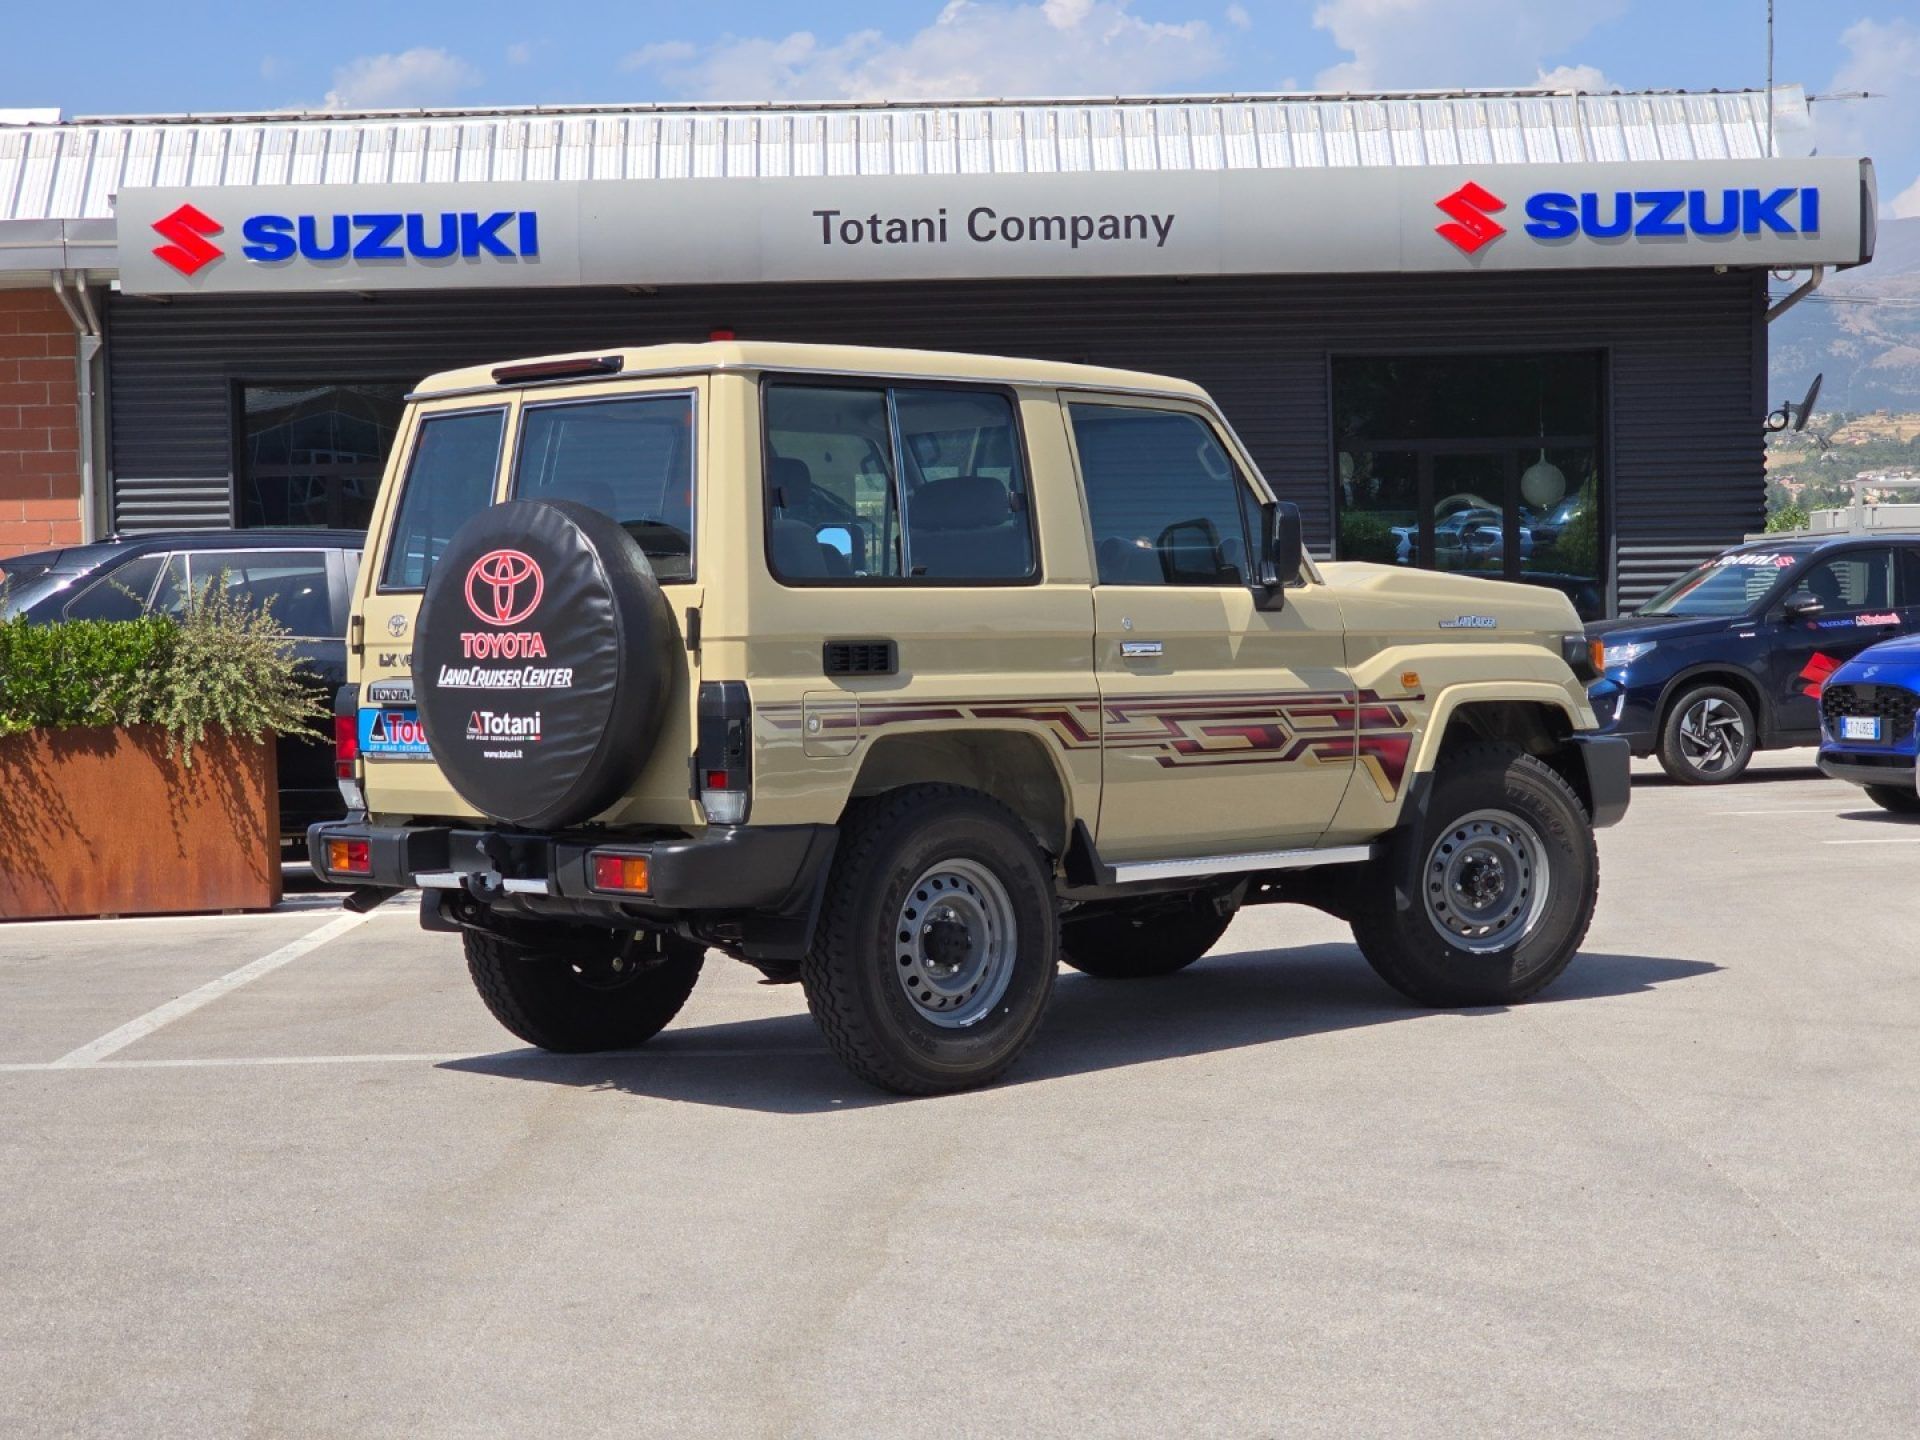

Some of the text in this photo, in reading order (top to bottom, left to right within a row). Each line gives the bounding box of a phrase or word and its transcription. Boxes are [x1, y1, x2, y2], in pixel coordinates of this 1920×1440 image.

[1524, 187, 1819, 240] SUZUKI
[242, 210, 538, 262] SUZUKI
[812, 207, 1175, 248] Totani Company
[460, 632, 547, 659] TOYOTA
[379, 654, 397, 667] LX
[375, 689, 408, 700] TOYOTA
[387, 713, 430, 745] Tot
[480, 711, 541, 734] Totani
[483, 749, 523, 758] www.totani.it
